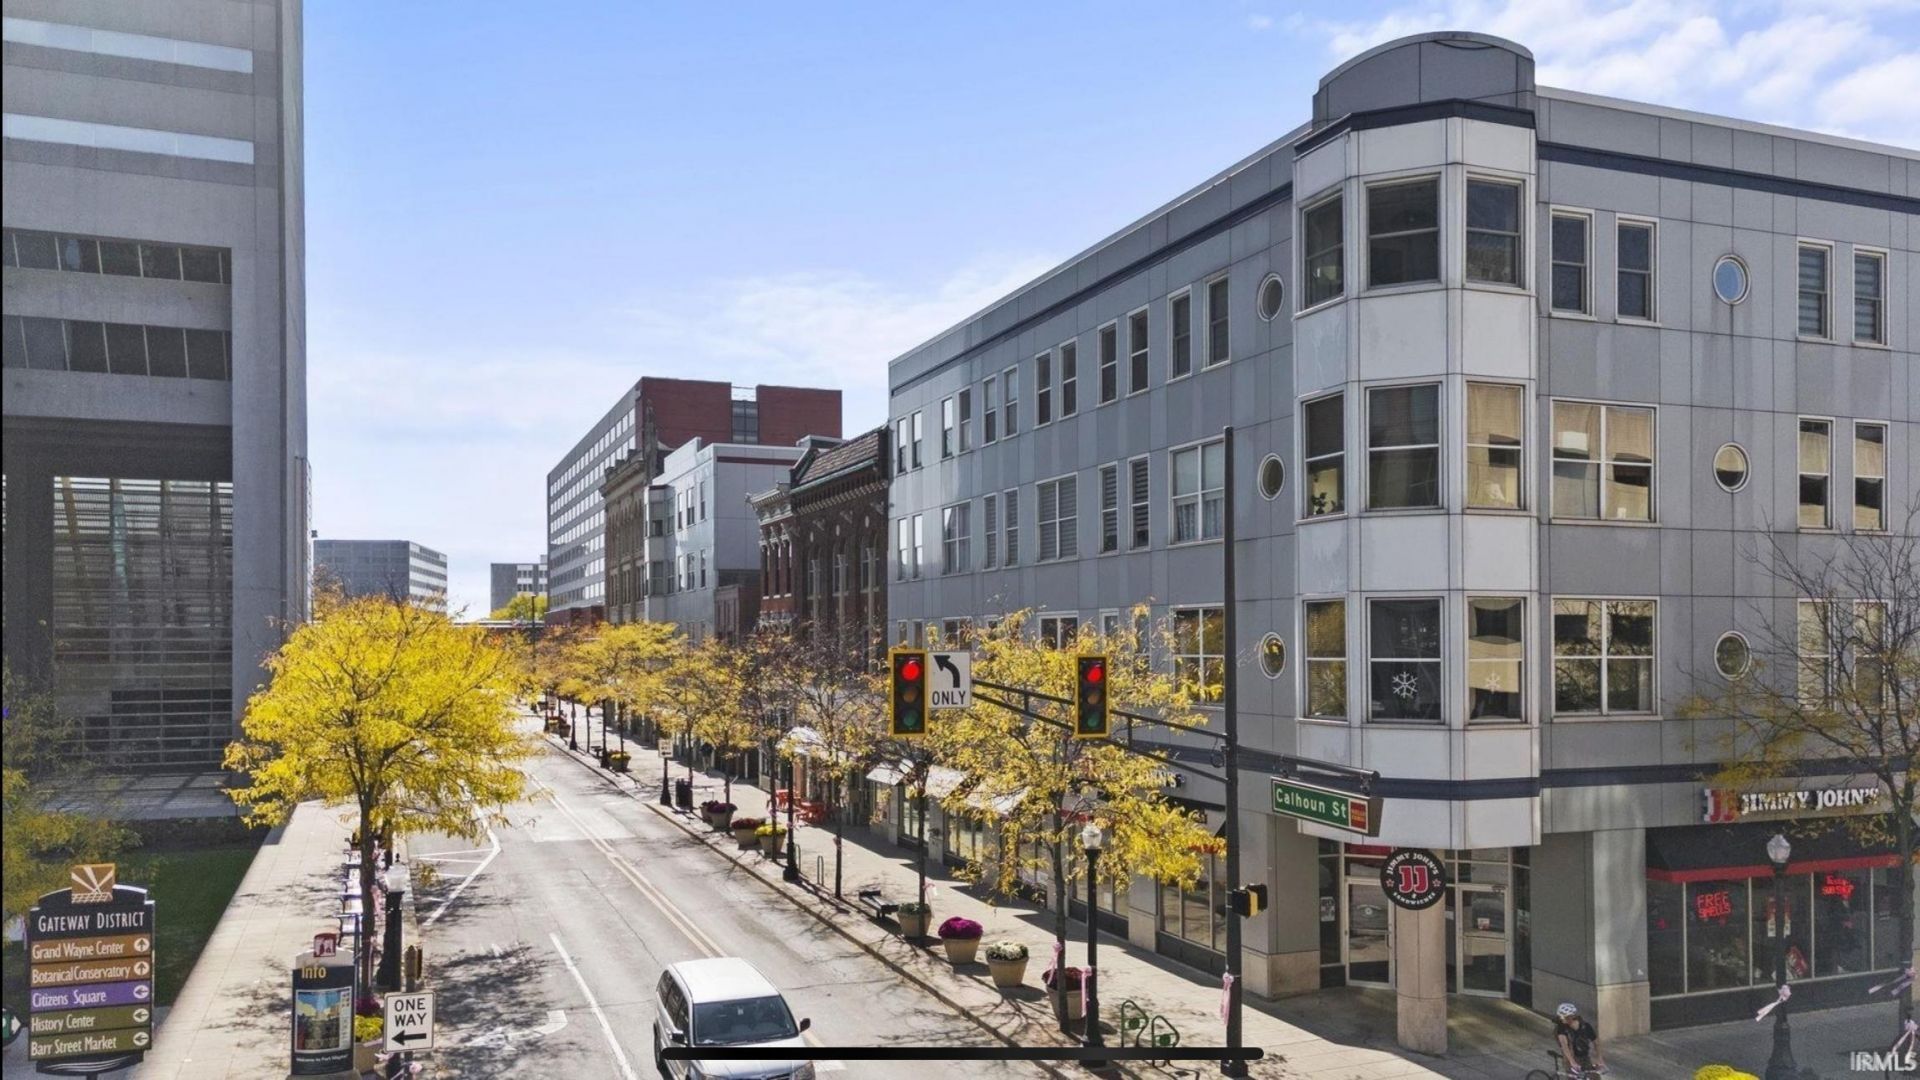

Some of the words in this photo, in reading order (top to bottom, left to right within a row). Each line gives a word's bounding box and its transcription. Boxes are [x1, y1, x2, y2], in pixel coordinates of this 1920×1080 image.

[932, 691, 966, 705] ONLY
[1276, 788, 1325, 813] Calhoun
[1332, 801, 1347, 819] St
[1741, 791, 1809, 816] JIMMY
[1386, 852, 1410, 875] JIMMY
[1413, 852, 1439, 875] JOHN'S
[1399, 865, 1428, 893] JJ
[1697, 891, 1729, 908] FREE
[38, 914, 90, 932] GATEWAY
[97, 911, 145, 929] DISTRICT
[32, 944, 61, 959] Grand
[64, 942, 94, 959] Wayne
[96, 939, 125, 954] Center
[32, 967, 73, 983] Botanical
[74, 964, 130, 981] Conservatory
[32, 992, 69, 1008] Citizens
[73, 989, 107, 1006] Square
[394, 998, 426, 1011] ONE
[31, 1016, 63, 1033] History
[66, 1014, 95, 1029] Center
[394, 1013, 427, 1027] WAY
[31, 1041, 52, 1057] Barr
[54, 1038, 82, 1055] Street
[84, 1036, 117, 1052] Market
